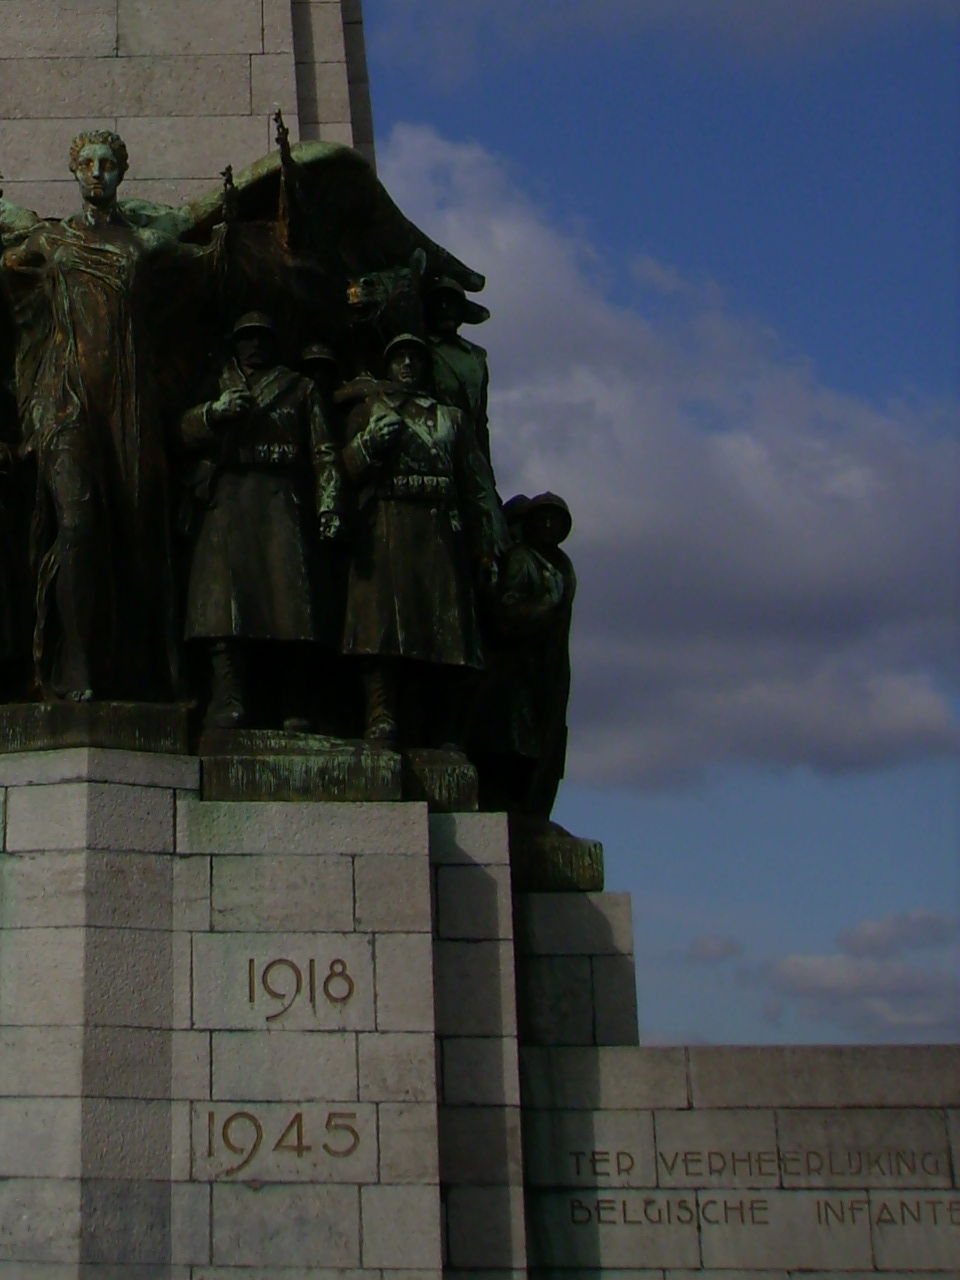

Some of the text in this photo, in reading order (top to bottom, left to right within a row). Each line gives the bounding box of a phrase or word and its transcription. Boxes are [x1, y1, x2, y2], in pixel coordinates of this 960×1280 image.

[248, 956, 356, 1022] 1918
[206, 1110, 361, 1177] 1945
[569, 1150, 941, 1178] TER VERHEERLIJKING
[569, 1199, 770, 1226] BELGISCHE
